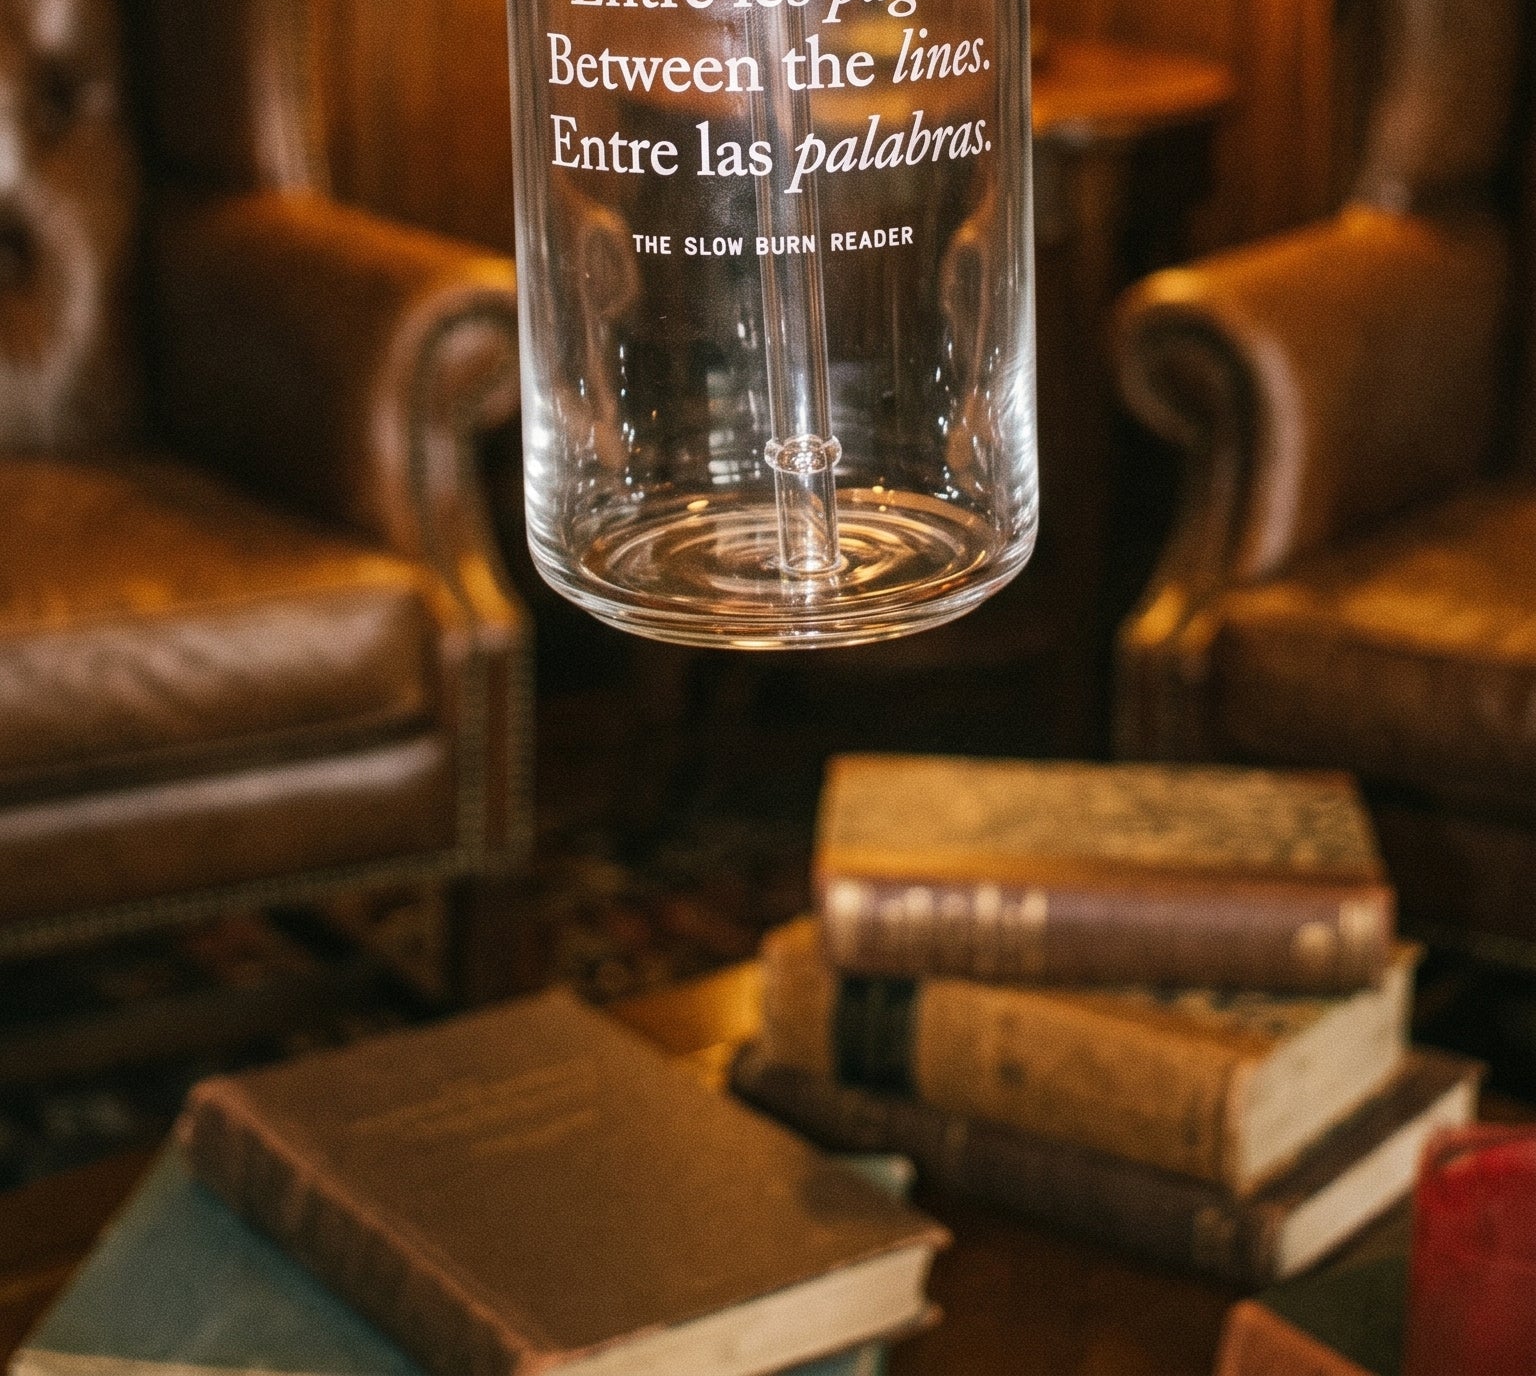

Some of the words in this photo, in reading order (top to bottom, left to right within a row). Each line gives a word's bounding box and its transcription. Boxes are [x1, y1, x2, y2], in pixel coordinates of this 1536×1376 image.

[547, 32, 764, 93] Between
[782, 35, 875, 90] the
[892, 28, 991, 84] lines.
[550, 114, 679, 176] Entre
[695, 120, 773, 177] las
[784, 110, 992, 194] palabras.
[632, 234, 671, 255] THE
[684, 236, 743, 256] SLOW
[755, 234, 816, 254] BURN
[830, 226, 914, 252] READER
